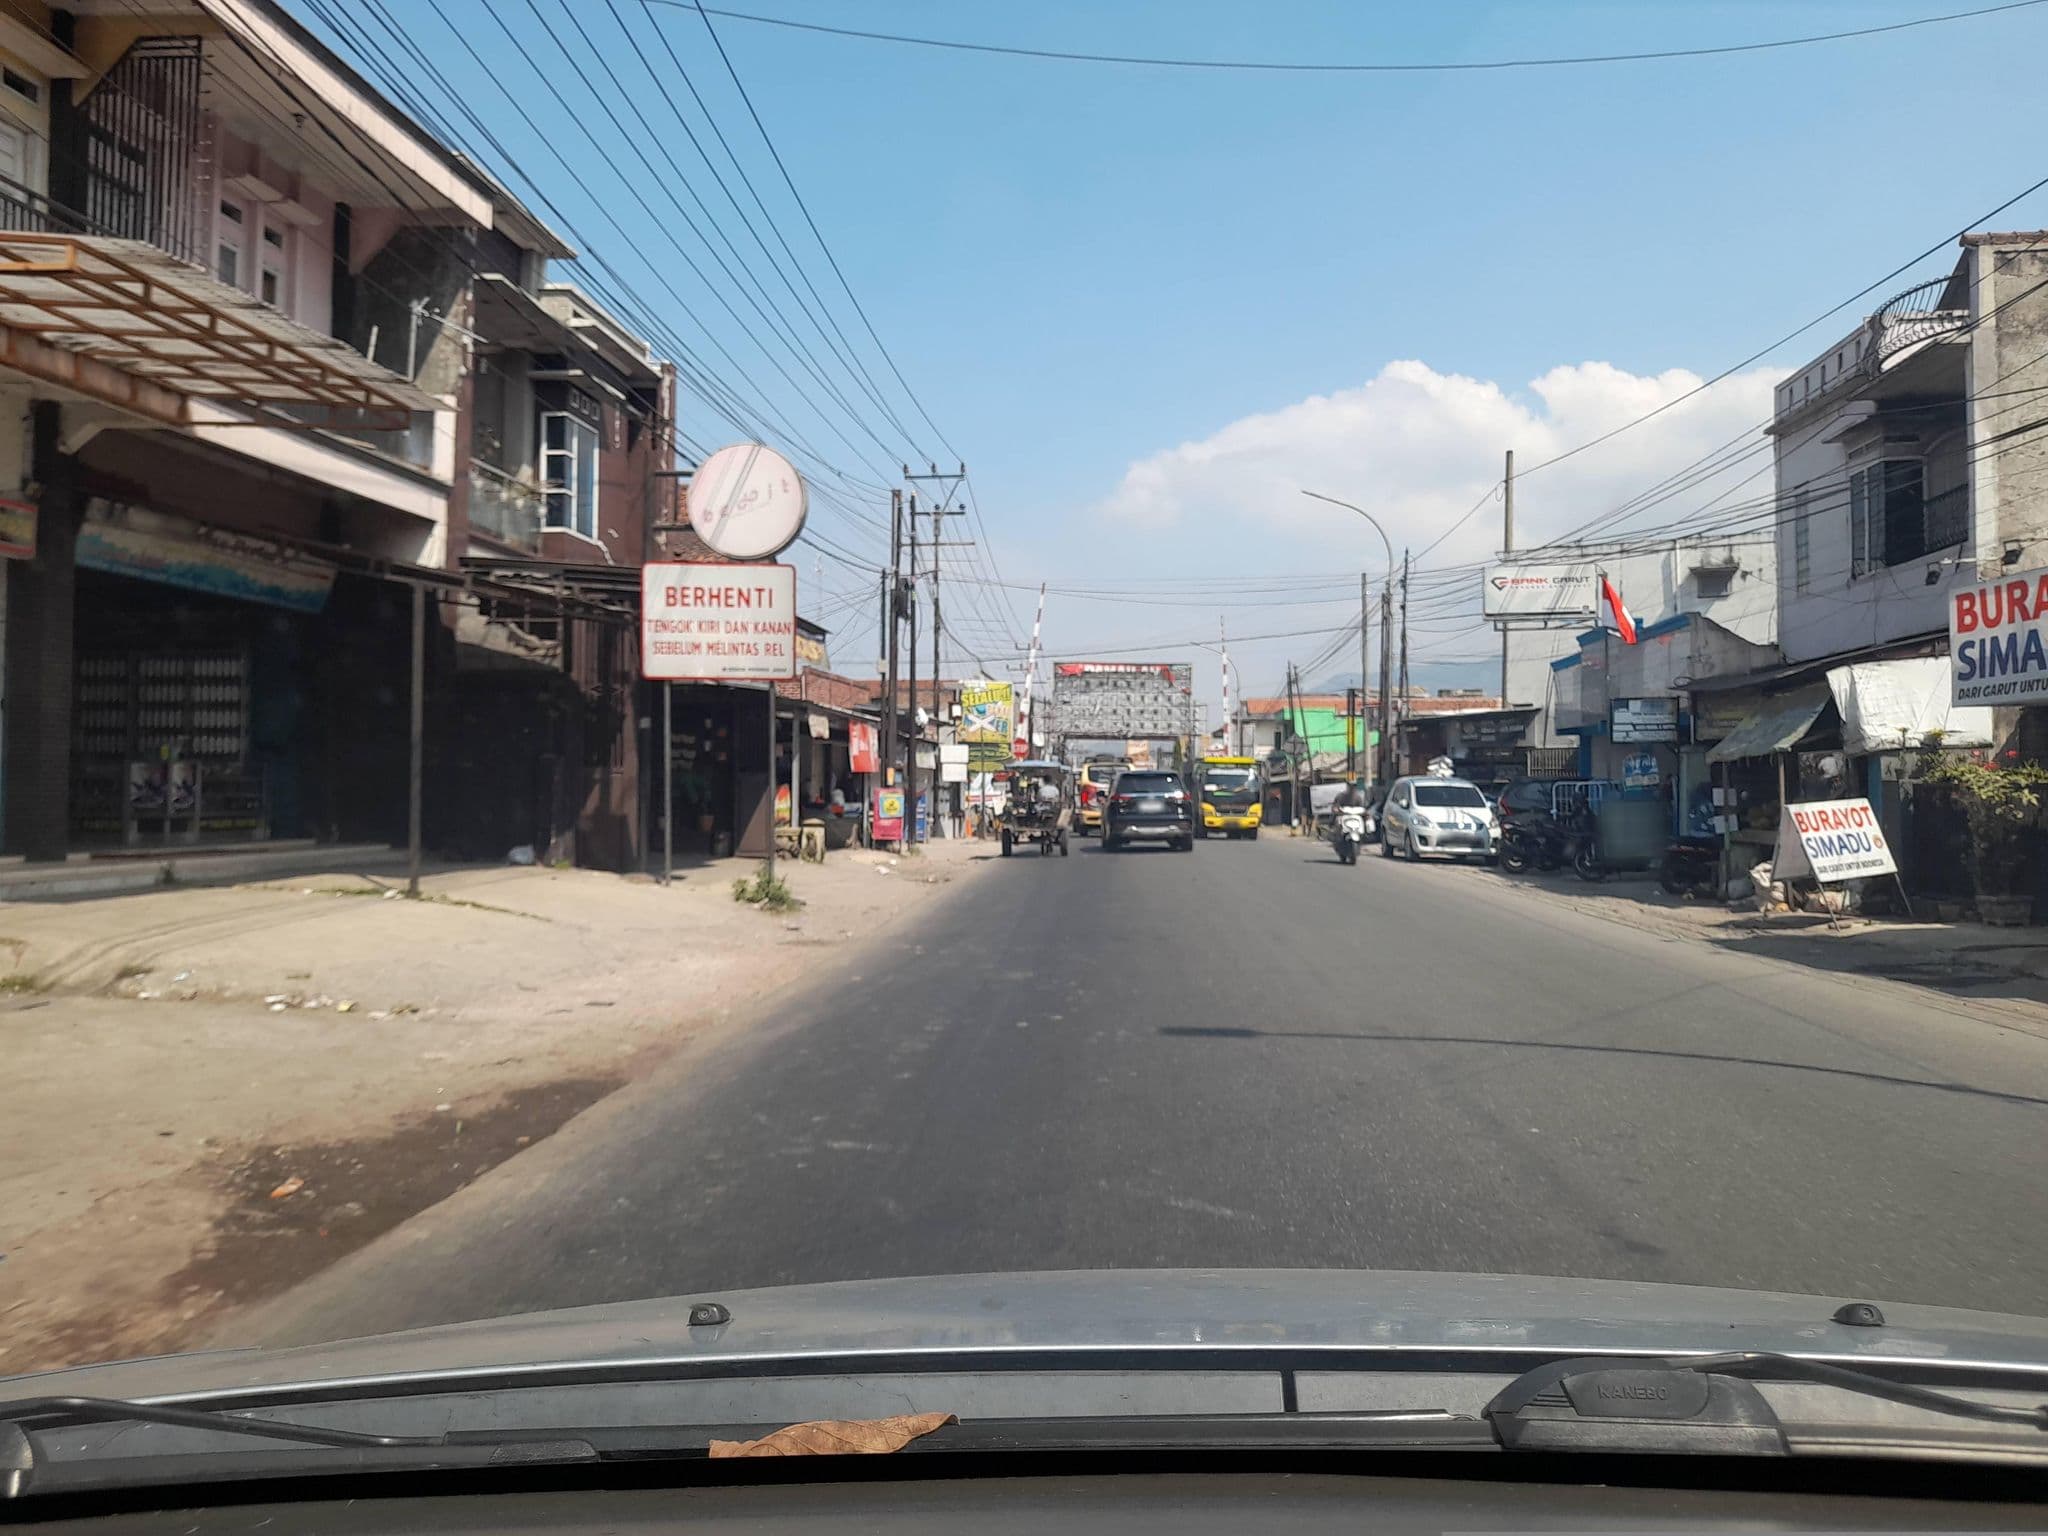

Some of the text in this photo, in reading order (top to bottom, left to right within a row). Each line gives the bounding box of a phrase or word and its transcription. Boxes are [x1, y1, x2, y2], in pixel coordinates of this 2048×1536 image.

[1510, 576, 1591, 585] BANK GARUT
[665, 586, 774, 608] BERHENTI
[648, 619, 792, 635] TENGOK KIRI DAN KANAN
[653, 640, 702, 656] SEBELUM
[707, 642, 759, 657] MELINTAS
[764, 643, 785, 657] REL
[1957, 628, 2047, 682] SIMA
[1958, 685, 1983, 701] DARI
[1983, 682, 2018, 698] GARUT
[1794, 807, 1873, 833] BURAYOT
[1805, 832, 1872, 858] SIMADU
